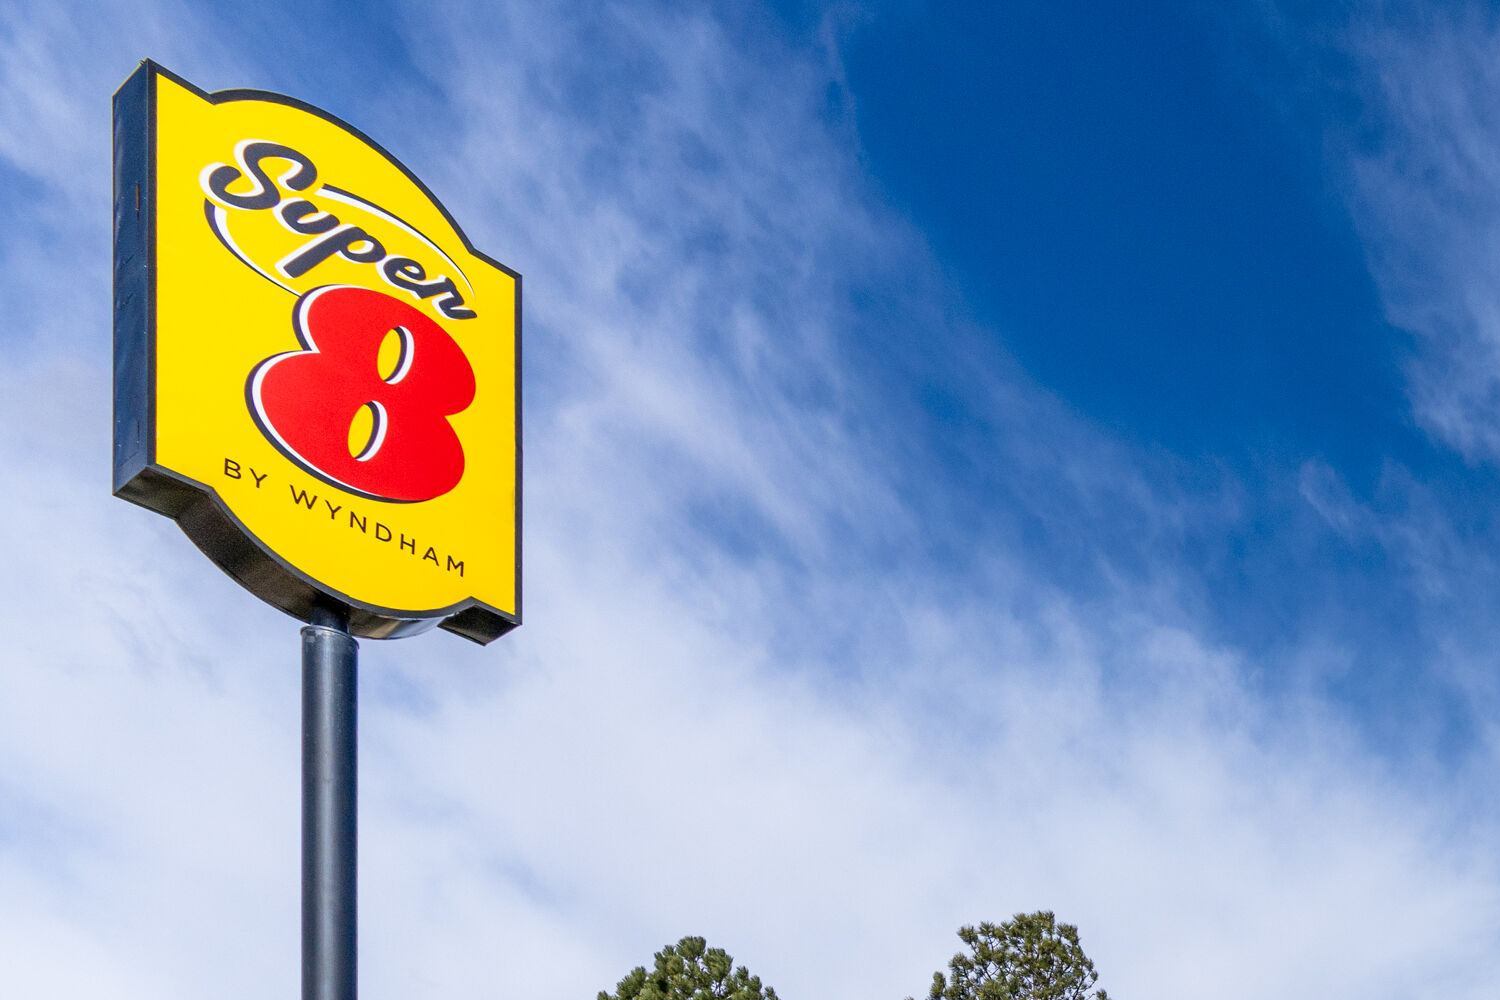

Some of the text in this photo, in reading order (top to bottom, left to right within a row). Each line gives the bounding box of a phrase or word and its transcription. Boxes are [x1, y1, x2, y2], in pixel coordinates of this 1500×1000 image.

[200, 139, 478, 320] Super
[245, 284, 477, 504] 8
[223, 457, 465, 578] BY WYNDHAM
